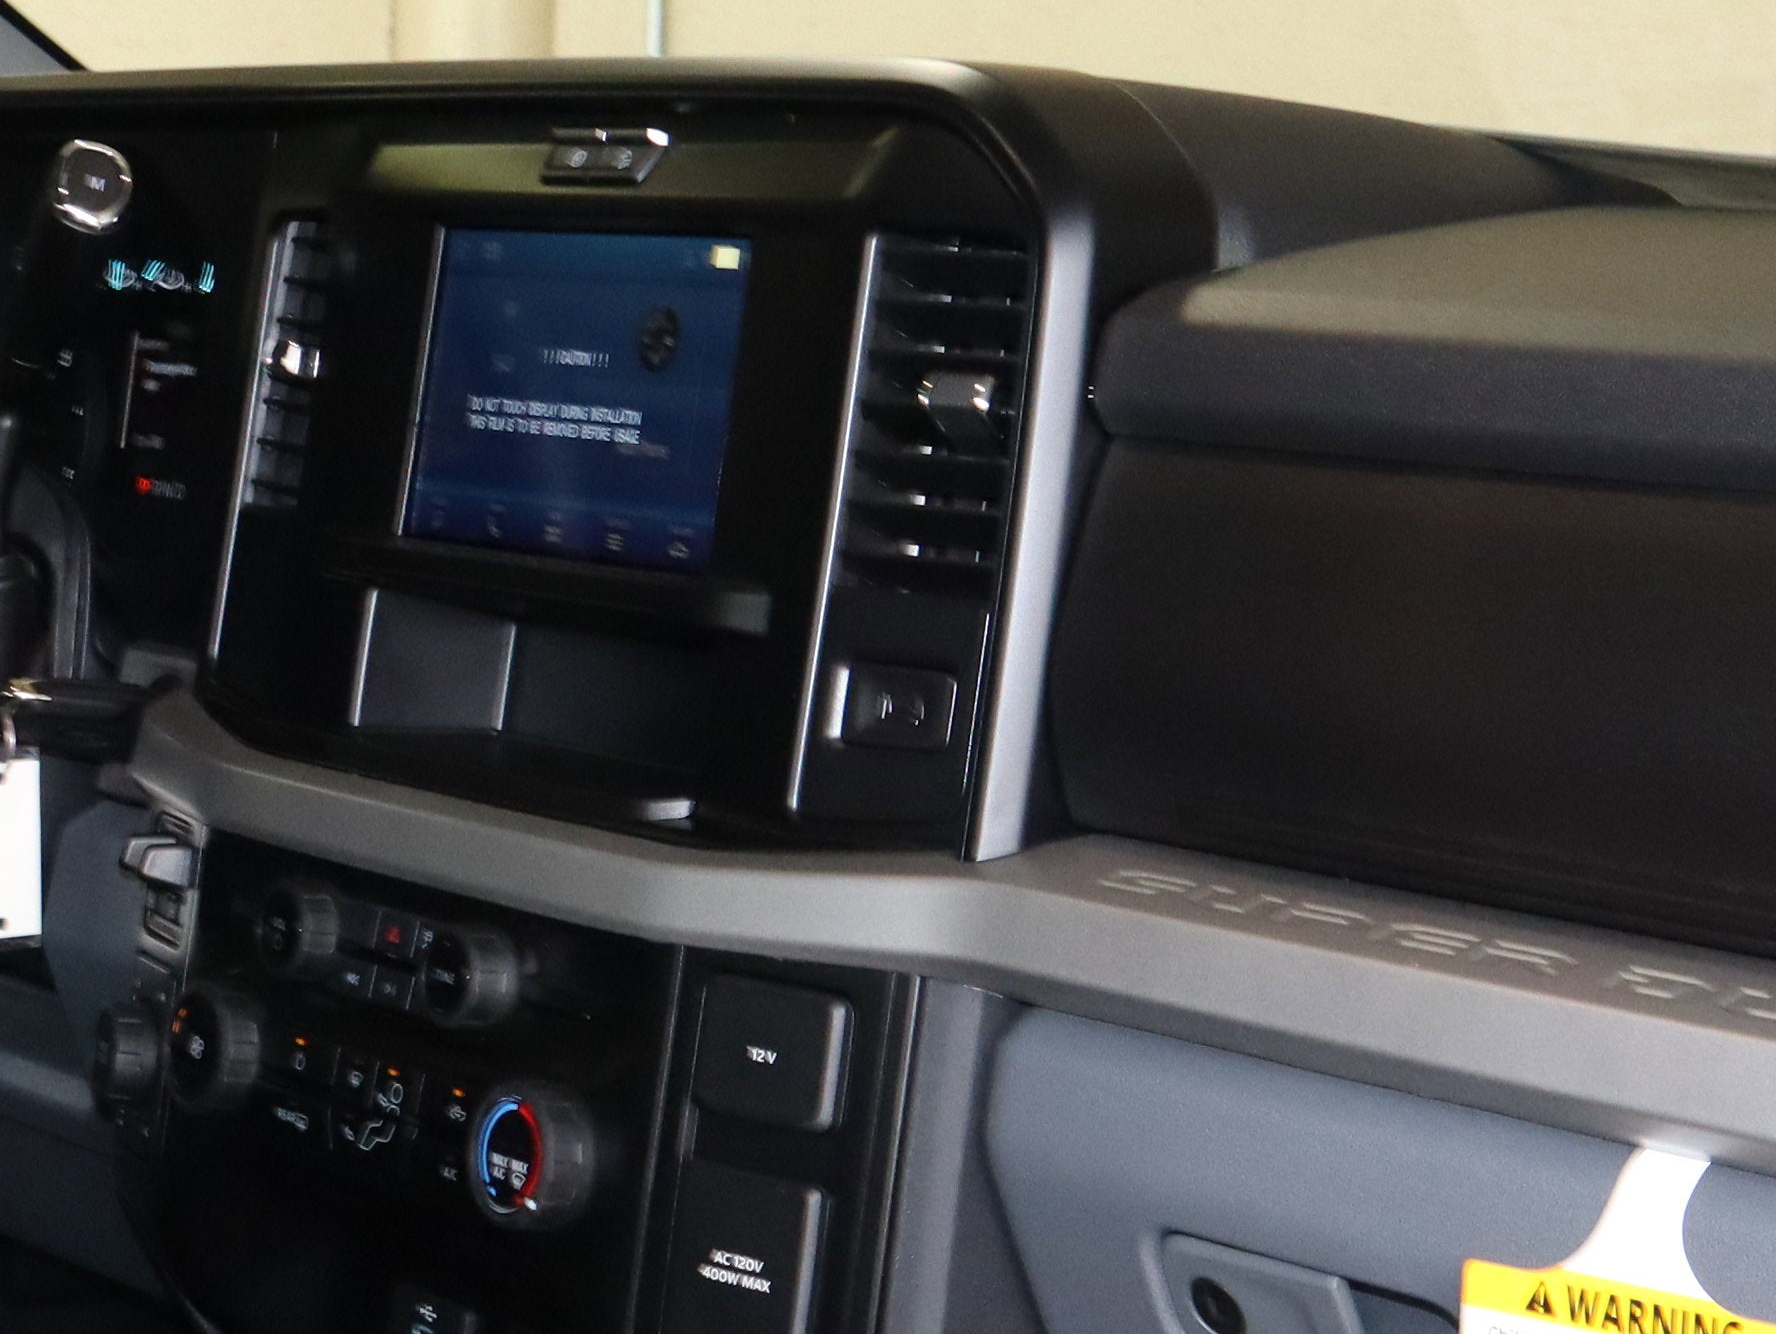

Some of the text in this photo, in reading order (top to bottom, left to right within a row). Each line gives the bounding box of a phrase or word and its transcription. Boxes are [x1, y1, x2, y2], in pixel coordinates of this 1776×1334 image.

[484, 398, 501, 412] NOT
[502, 399, 526, 414] TOUCH
[528, 400, 557, 418] DISPLAY
[559, 404, 589, 421] DURING
[590, 406, 642, 425] INSTALLATION
[543, 421, 580, 439] REMOVED
[581, 425, 611, 442] BEFORE
[1097, 867, 1578, 980] SUPER
[713, 1250, 764, 1274] AC 120V
[701, 1265, 771, 1294] 400W MAX
